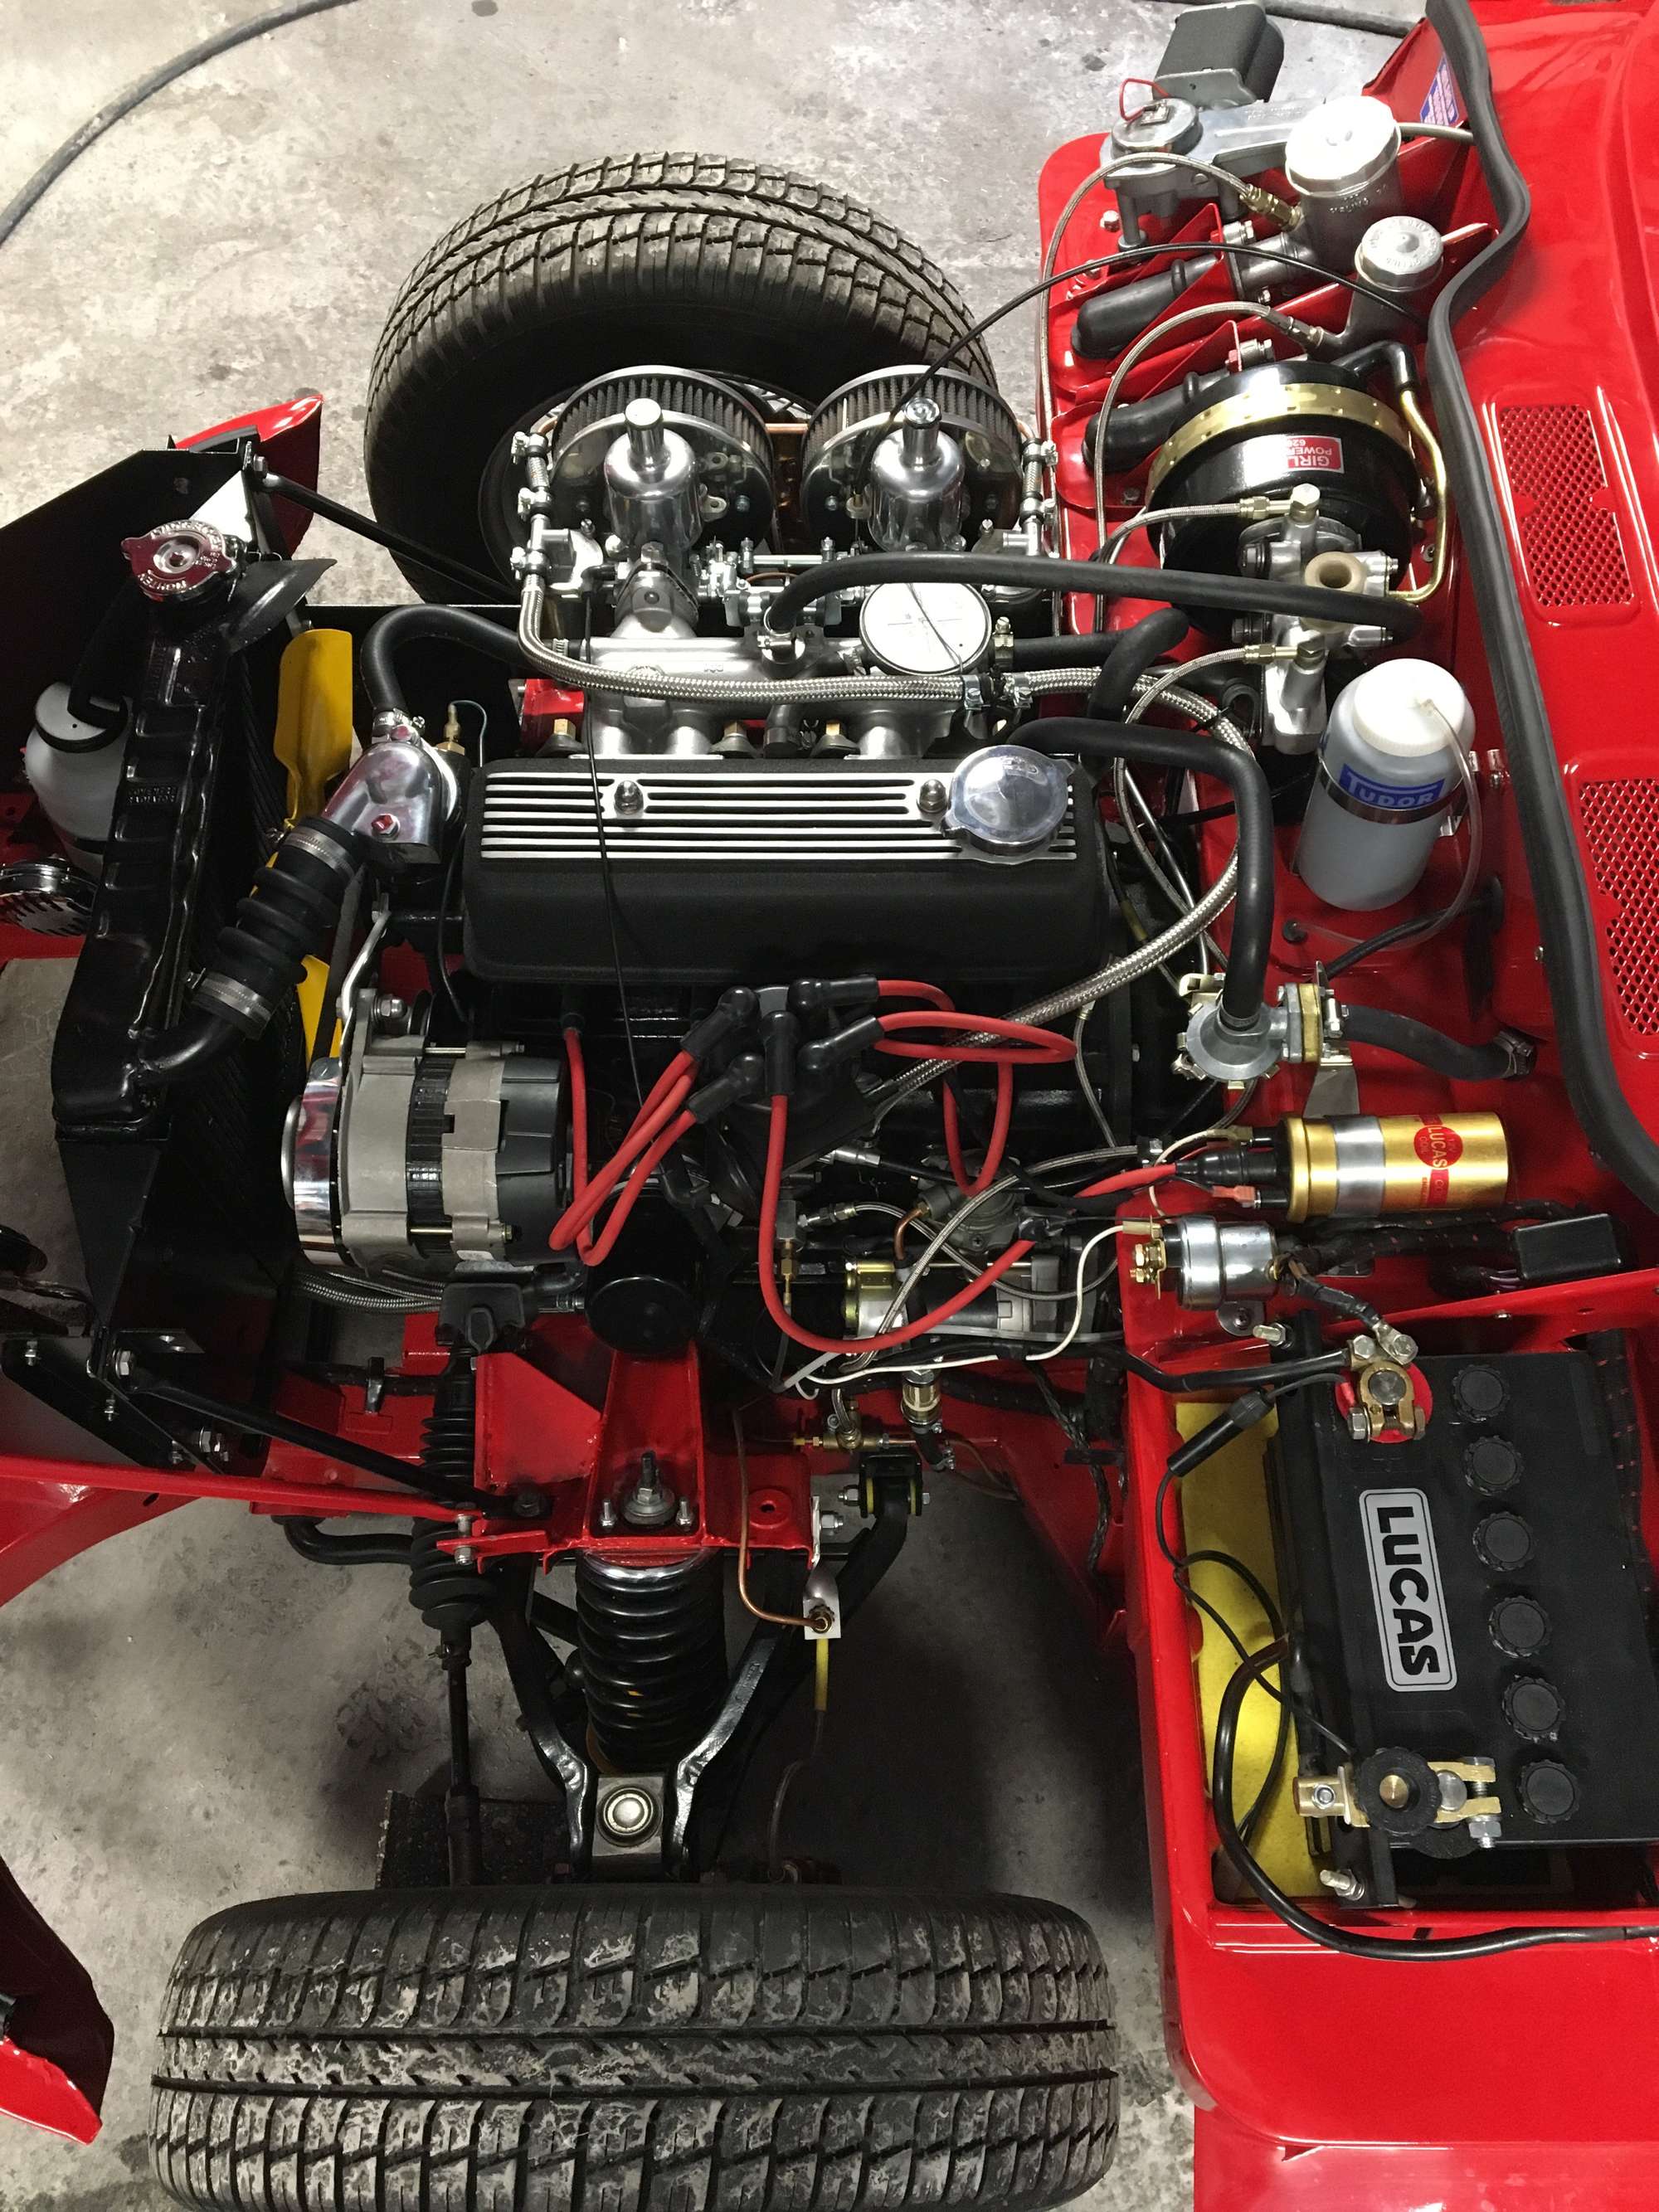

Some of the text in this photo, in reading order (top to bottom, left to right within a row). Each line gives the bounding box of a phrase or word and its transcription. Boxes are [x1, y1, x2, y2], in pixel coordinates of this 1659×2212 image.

[1287, 455, 1331, 467] GIRL
[1346, 771, 1438, 806] TUDOR
[1427, 1126, 1448, 1169] LUCAS
[1377, 1506, 1440, 1675] LUCAS
